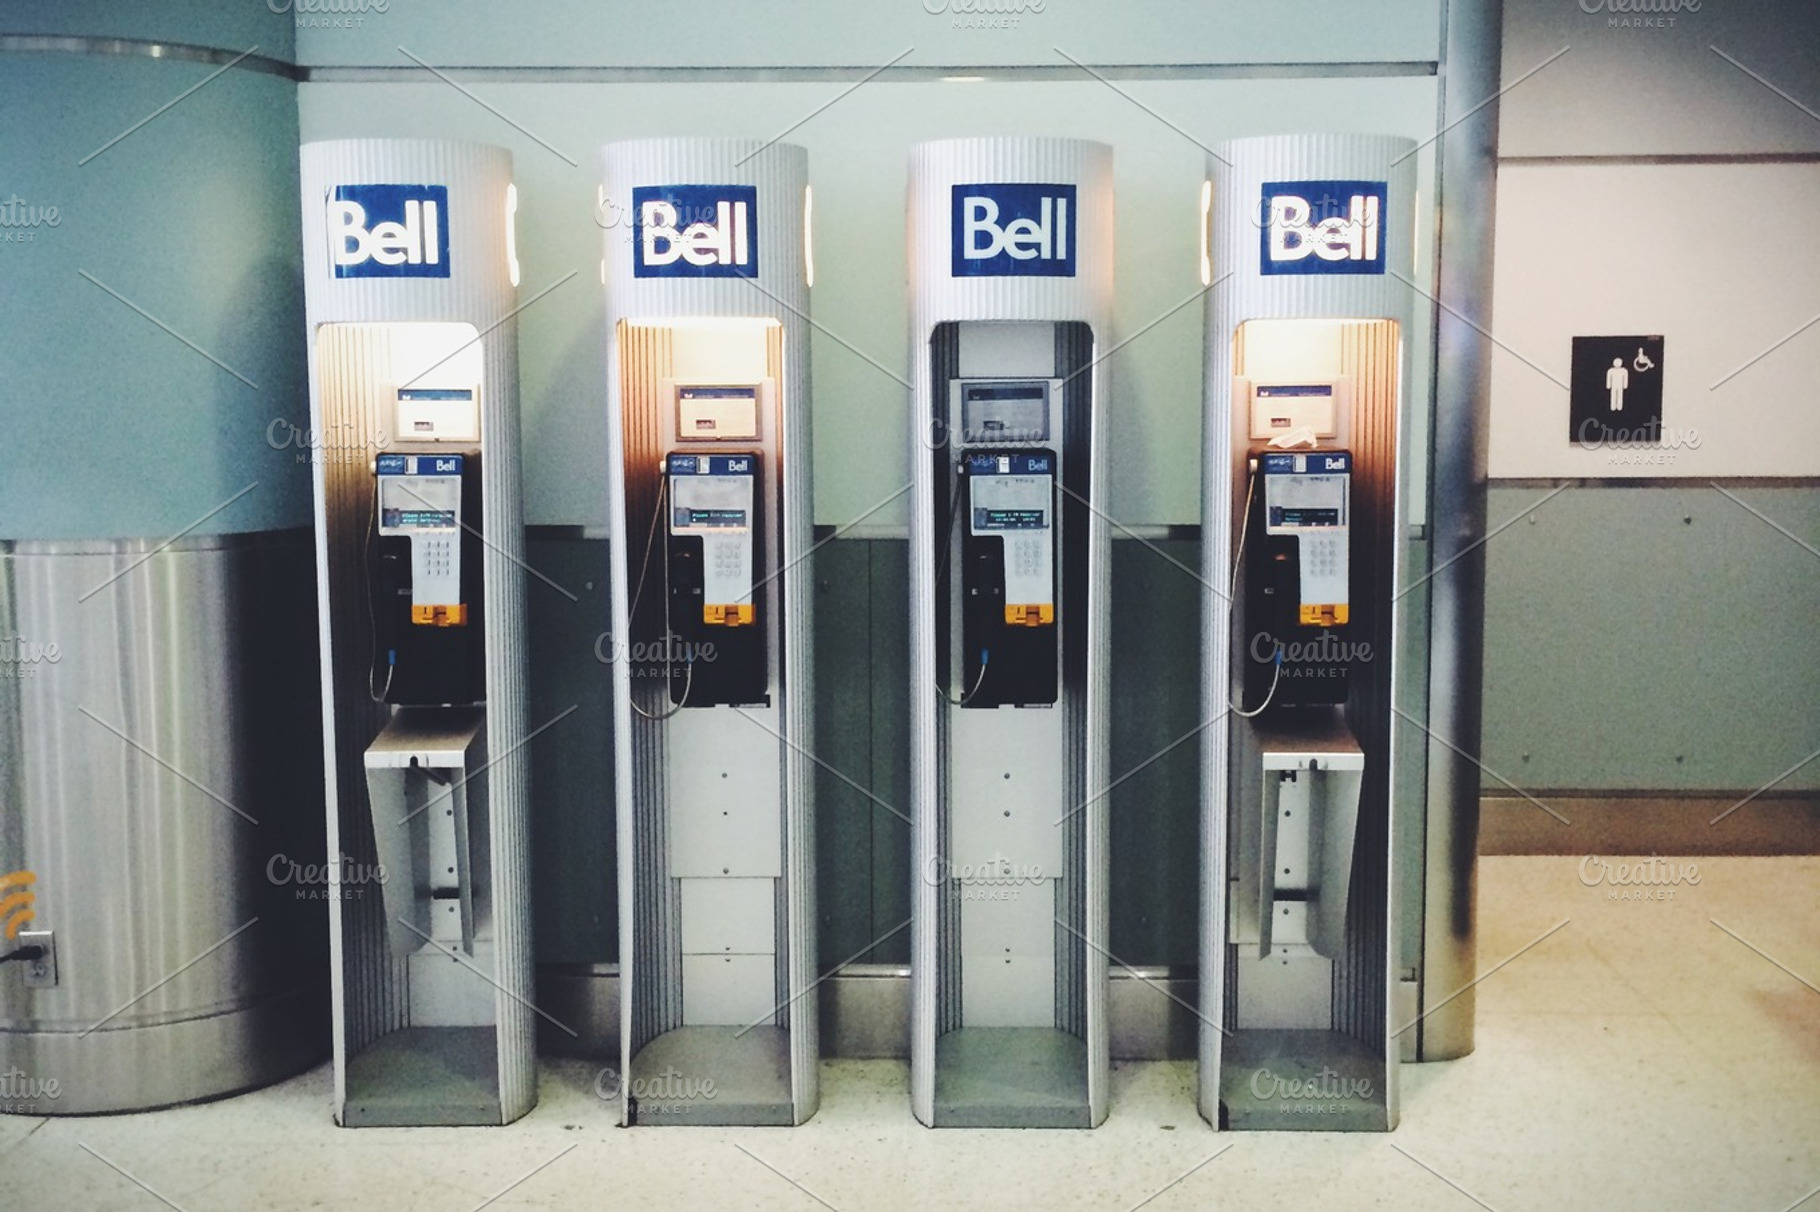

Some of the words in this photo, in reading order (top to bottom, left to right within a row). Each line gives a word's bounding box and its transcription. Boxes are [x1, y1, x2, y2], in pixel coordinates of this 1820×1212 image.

[327, 200, 438, 265] Bell
[642, 200, 748, 266] Bell
[963, 196, 1067, 260] Bell
[1270, 195, 1379, 261] Bell
[436, 459, 456, 471] Bell
[728, 459, 748, 472] Bell
[1028, 459, 1048, 471] Bell
[1325, 457, 1345, 470] Bell
